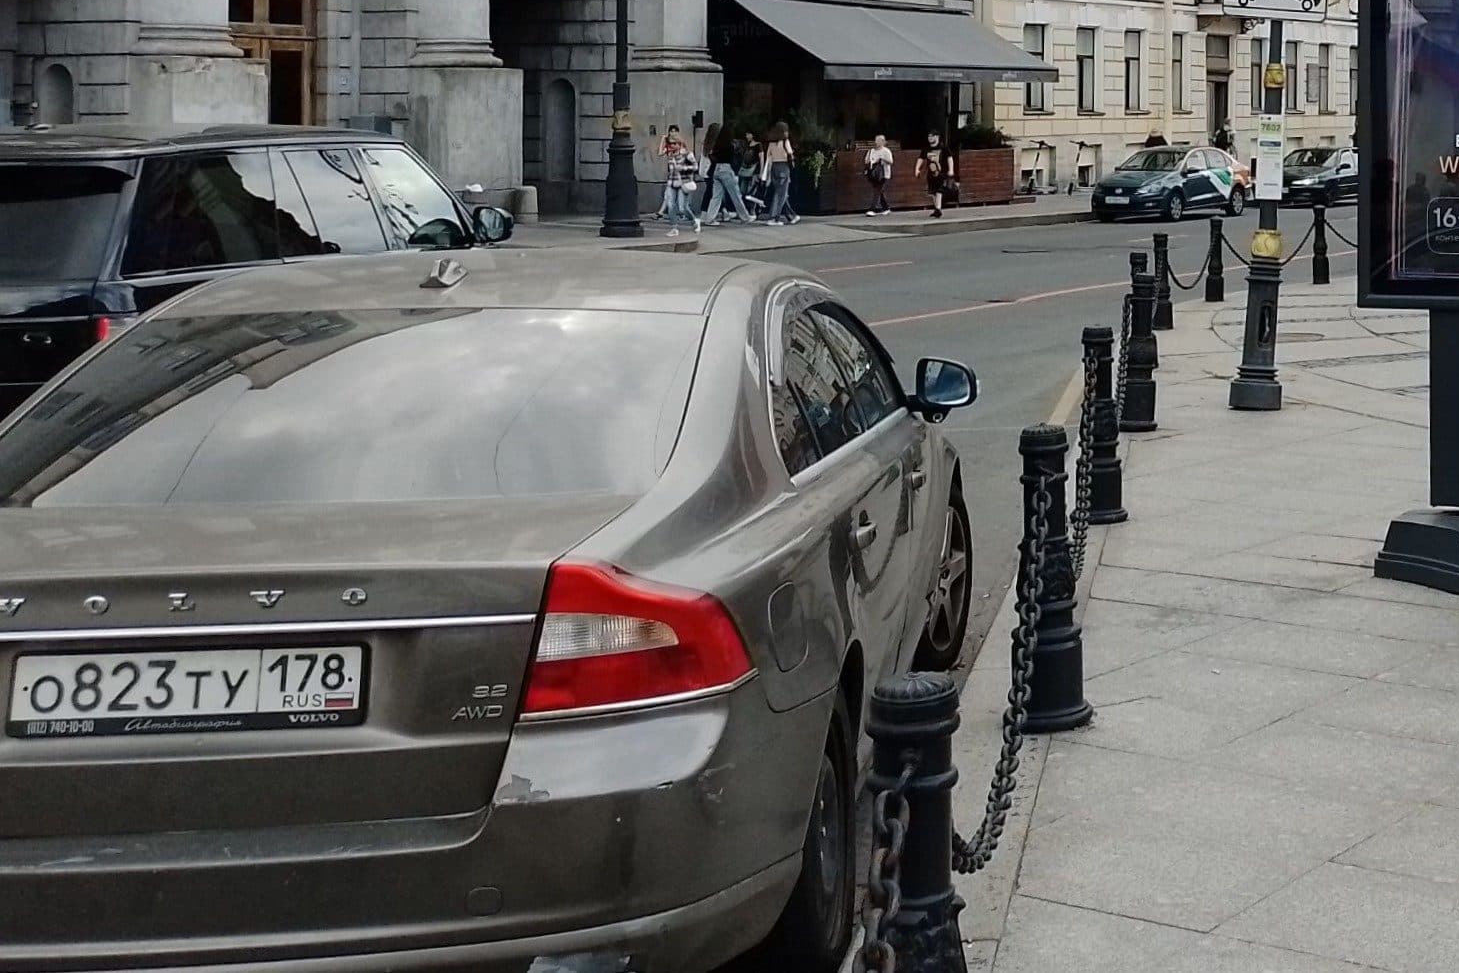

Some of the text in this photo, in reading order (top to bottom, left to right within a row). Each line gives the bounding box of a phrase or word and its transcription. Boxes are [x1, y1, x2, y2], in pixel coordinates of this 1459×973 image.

[268, 653, 346, 692] 178
[281, 694, 323, 709] RUS
[288, 712, 340, 724] VOLVO
[451, 704, 504, 721] AWD
